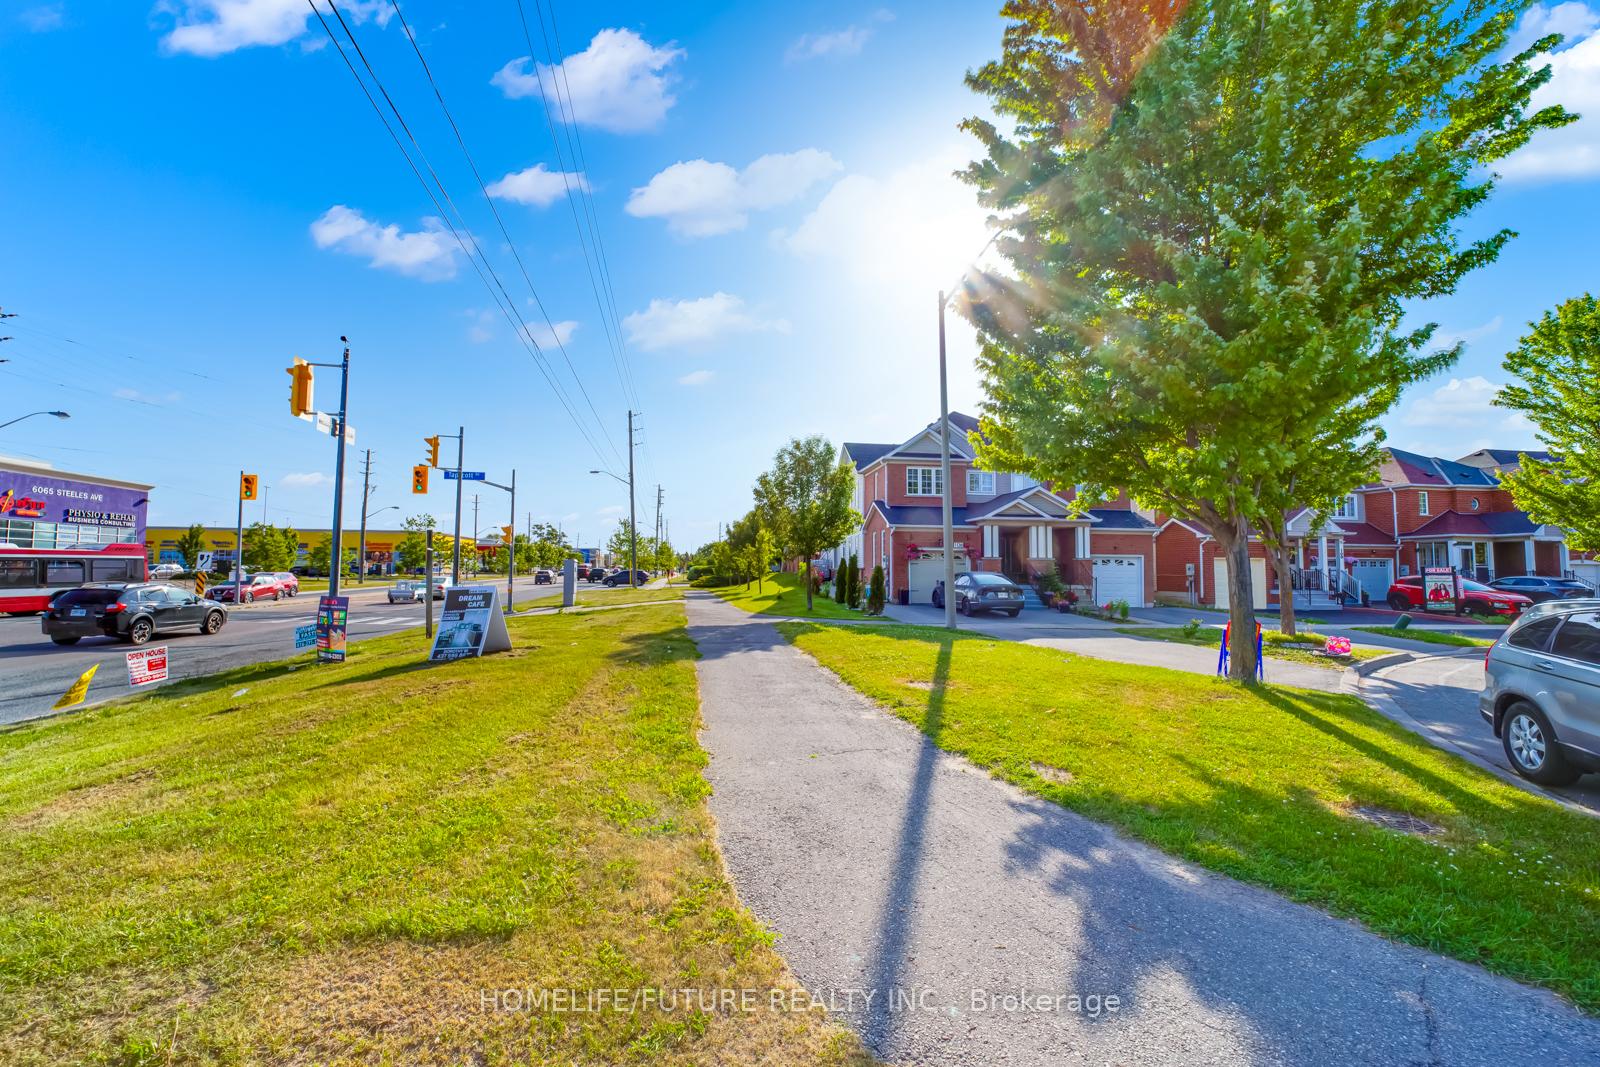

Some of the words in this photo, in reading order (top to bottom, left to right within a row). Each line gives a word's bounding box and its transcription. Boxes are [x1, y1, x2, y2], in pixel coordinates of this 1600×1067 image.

[32, 485, 54, 495] 6065
[56, 488, 89, 500] STEELES
[90, 493, 103, 501] AVE
[68, 516, 99, 525] BUSINESS
[100, 519, 136, 528] CONSULTING
[69, 508, 100, 519] PHYSIO
[101, 512, 108, 520] &
[110, 512, 136, 522] REHAB
[458, 594, 483, 602] DREAM
[128, 652, 144, 661] OPEN
[145, 647, 166, 658] HOUSE
